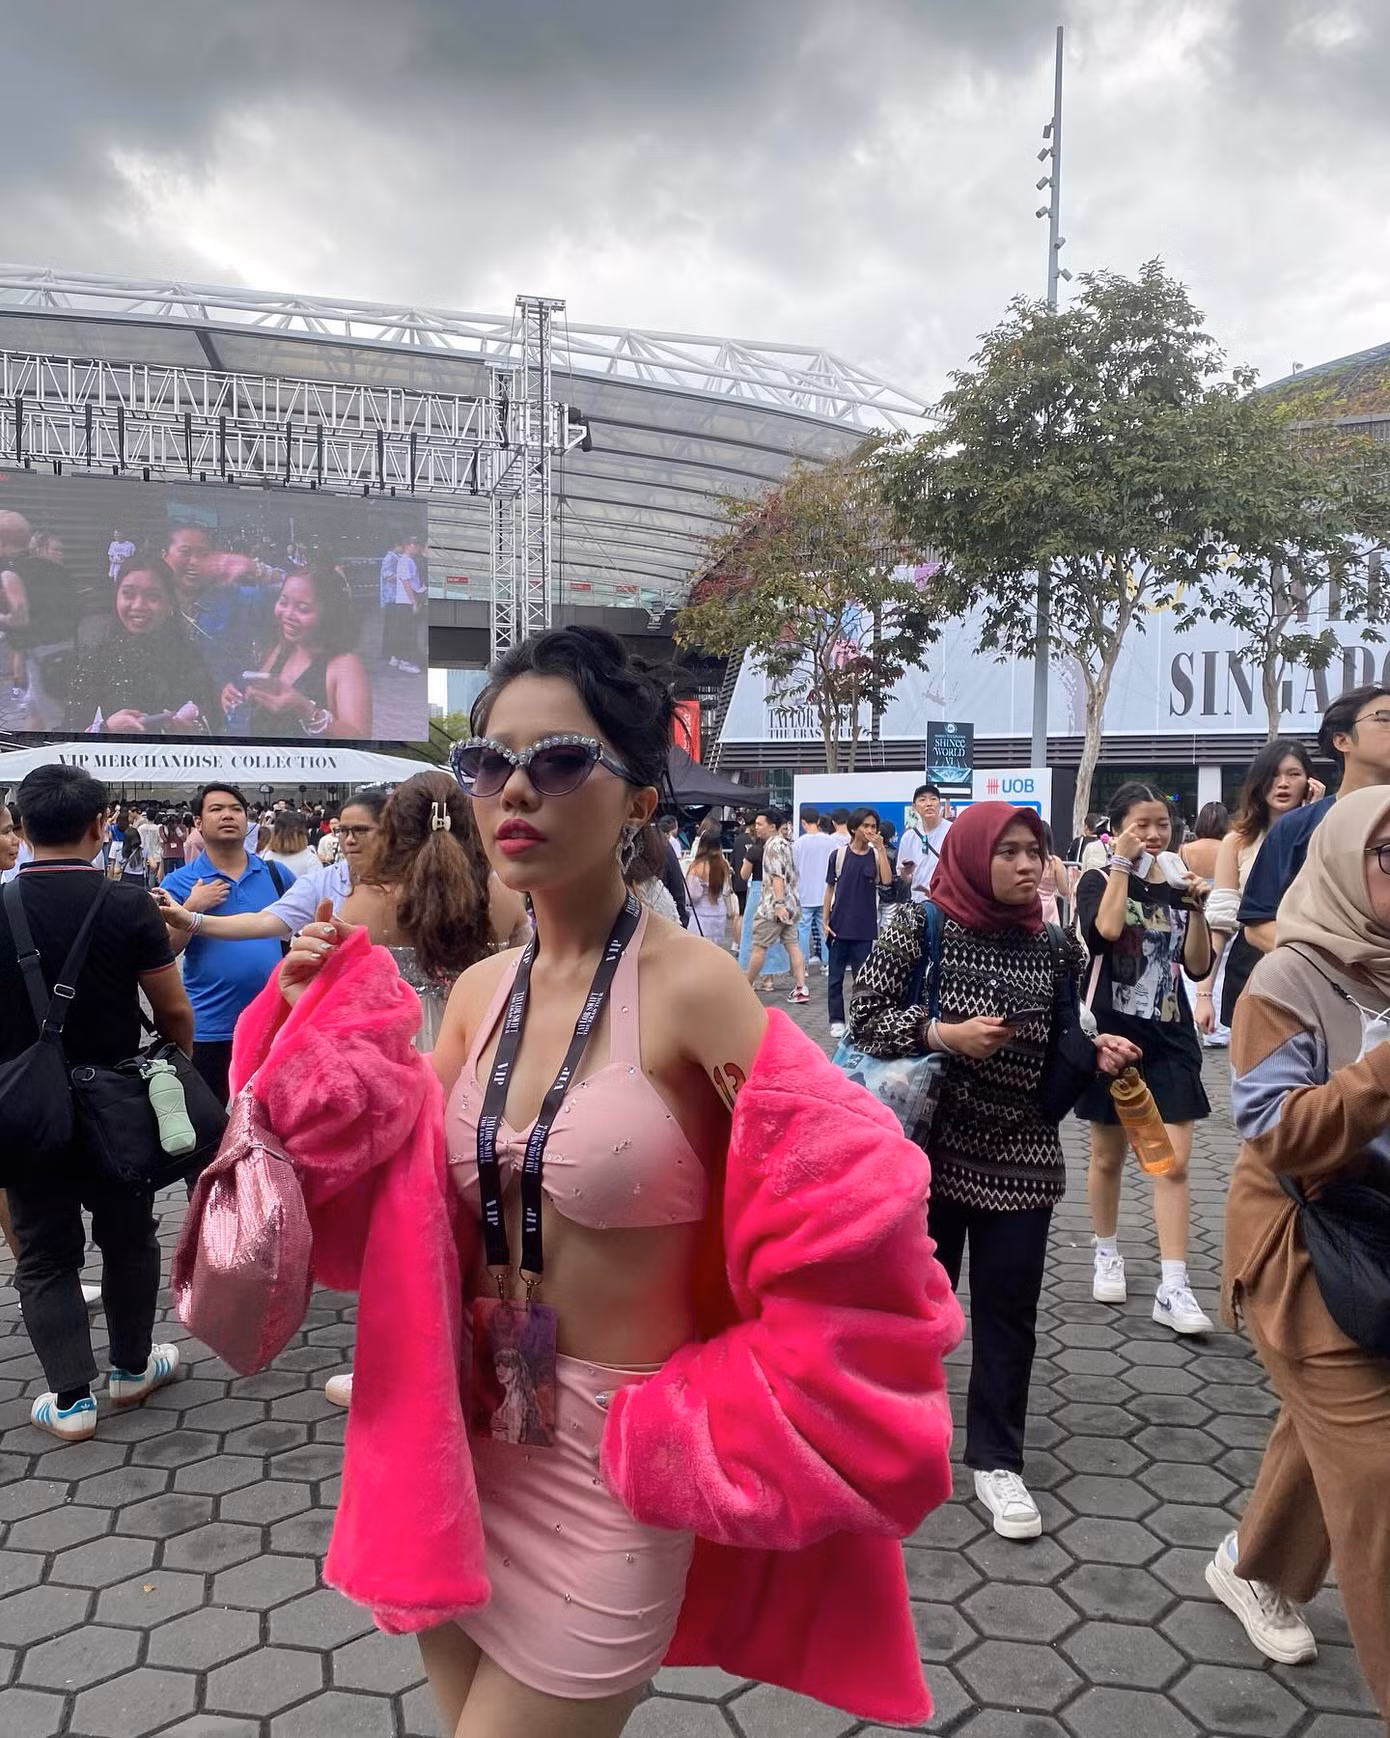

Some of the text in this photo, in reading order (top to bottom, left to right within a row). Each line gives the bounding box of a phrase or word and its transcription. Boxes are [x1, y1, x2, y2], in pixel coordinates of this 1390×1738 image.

[1170, 646, 1390, 717] SINGAP
[768, 728, 791, 739] THE
[793, 728, 821, 739] ERAS
[58, 753, 338, 769] VIP MERCHANDISE COLLECTION
[933, 747, 965, 757] WORLD
[1002, 778, 1034, 793] UOB
[606, 939, 622, 962] VIP
[494, 1063, 508, 1086] VIP
[553, 1066, 571, 1091] VIP
[484, 1116, 497, 1141] TAYLOR
[486, 1200, 499, 1227] VIP
[526, 1207, 537, 1233] VIP
